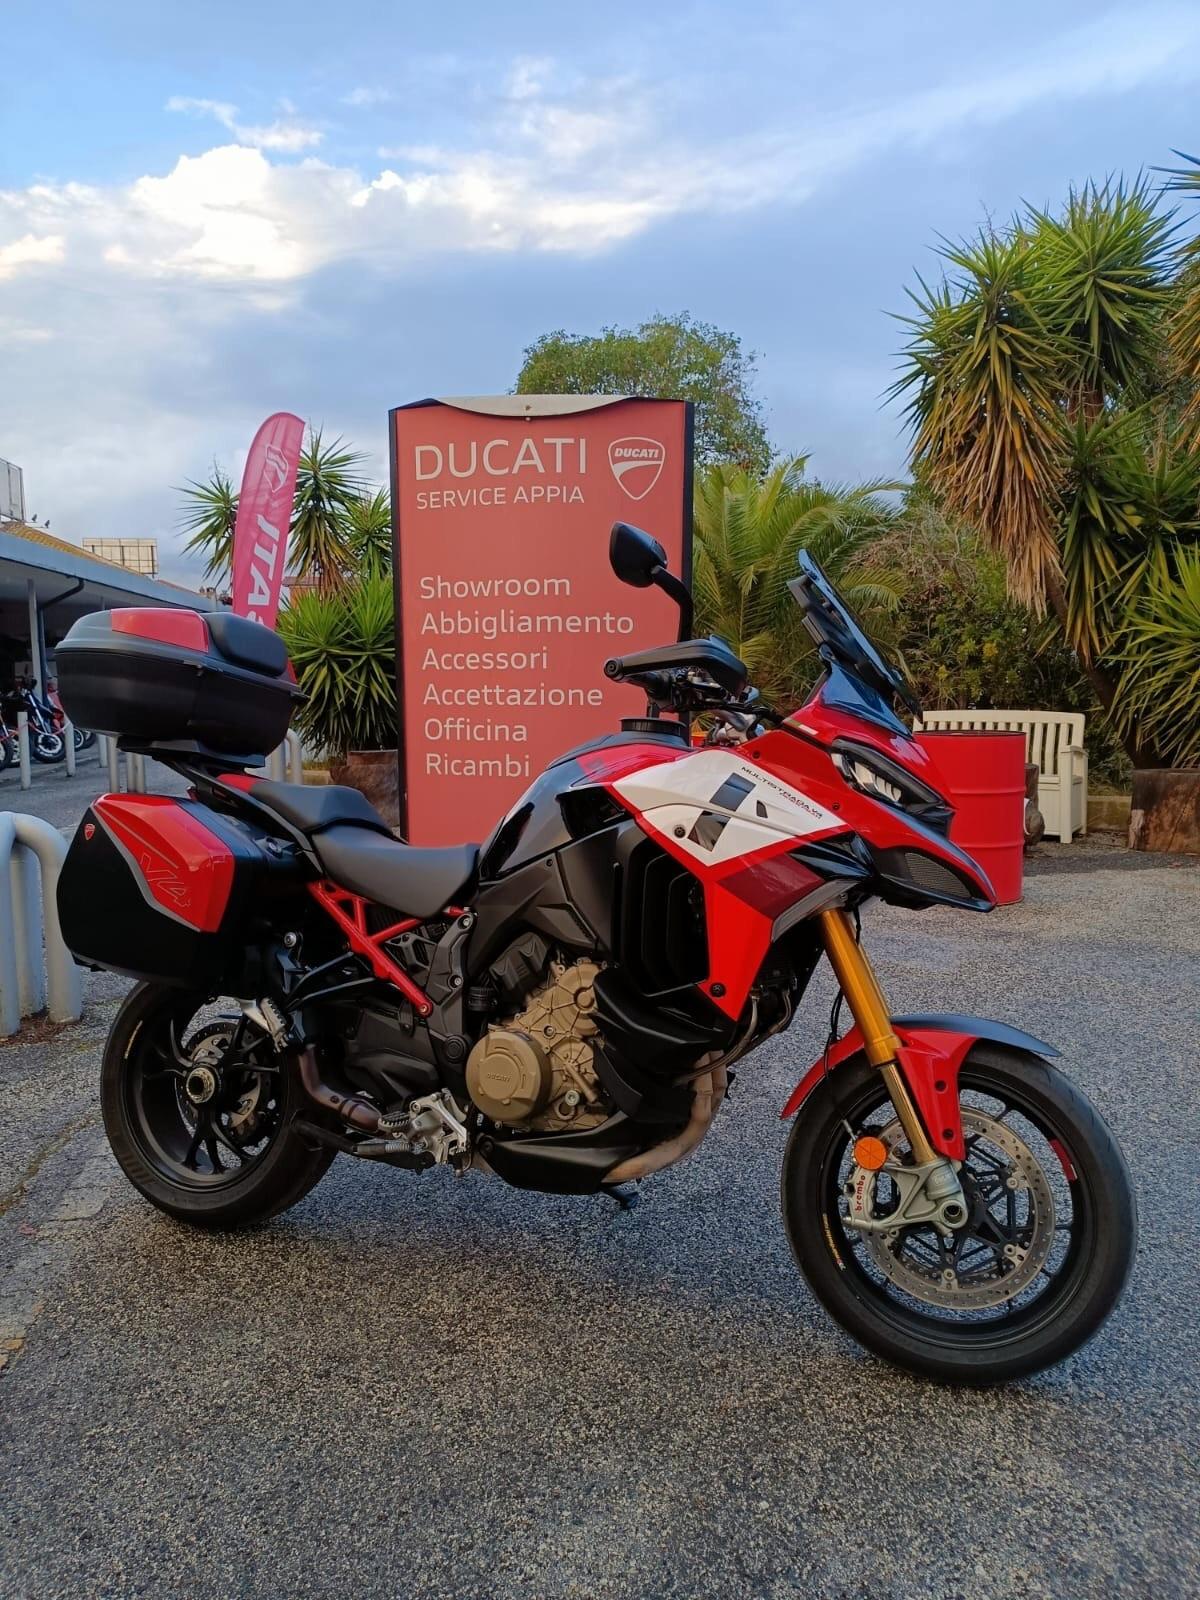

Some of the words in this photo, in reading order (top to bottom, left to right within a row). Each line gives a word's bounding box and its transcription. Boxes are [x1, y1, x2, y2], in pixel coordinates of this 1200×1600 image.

[415, 437, 586, 481] DUCATI
[614, 446, 660, 459] DUCATI
[416, 487, 507, 510] SERVICE
[513, 485, 585, 504] APPIA
[420, 575, 571, 599] Showroom
[421, 609, 634, 640] Abbigliamento
[422, 646, 548, 671] Accessori
[423, 683, 603, 706] Accettazione
[424, 717, 528, 742] Officina
[426, 752, 531, 777] Ricambi
[855, 1174, 866, 1212] brembo
